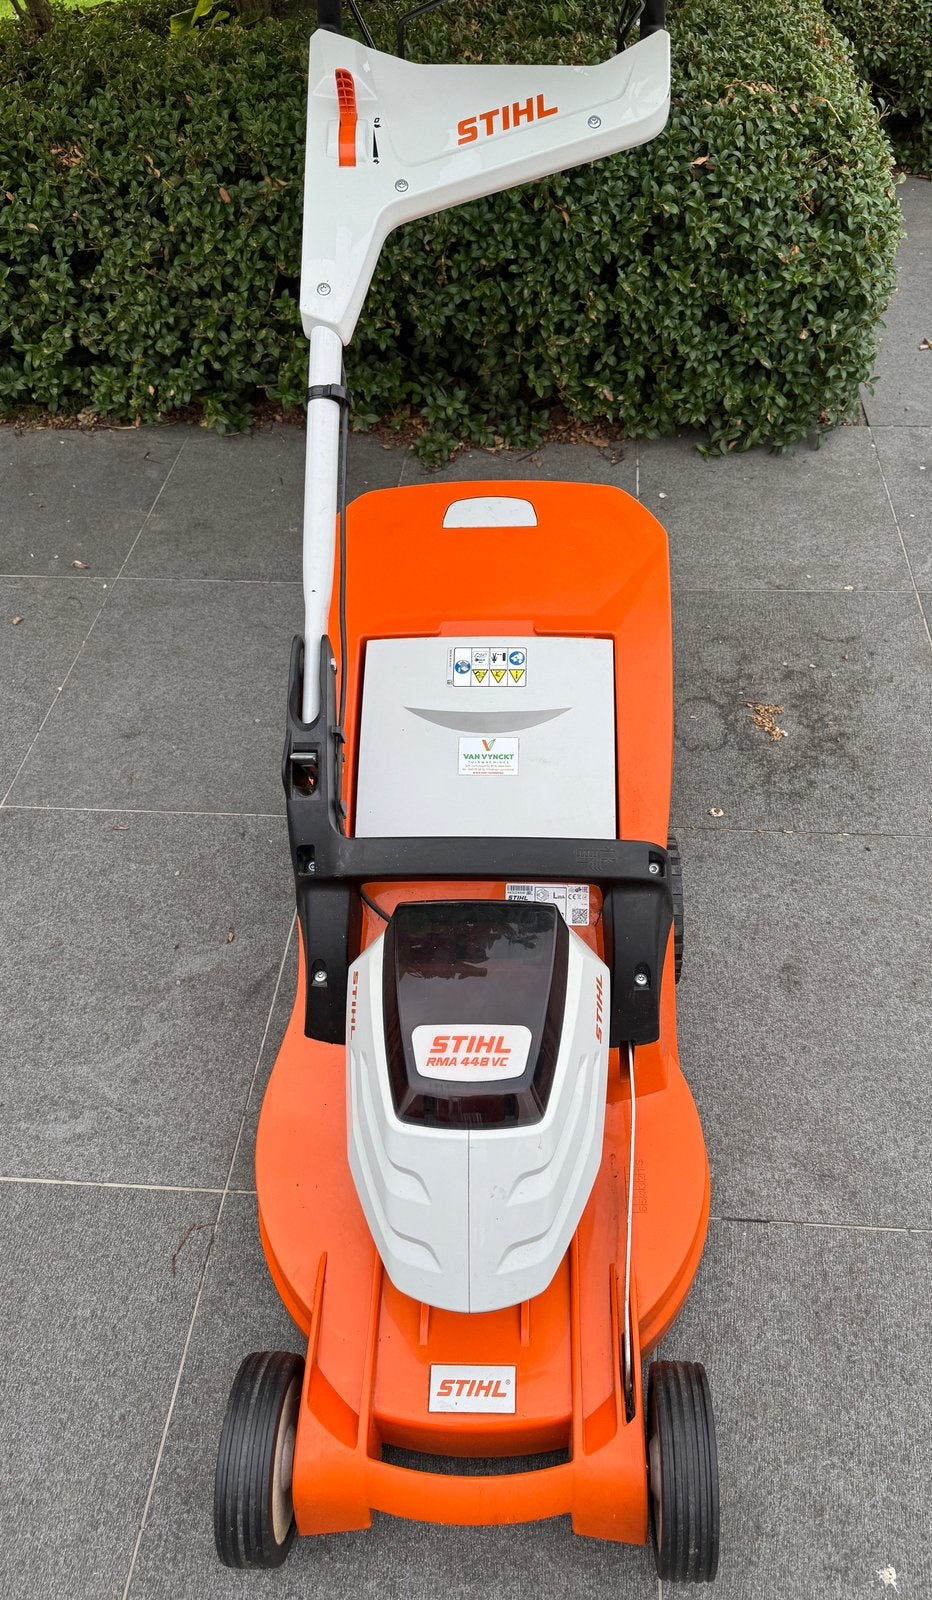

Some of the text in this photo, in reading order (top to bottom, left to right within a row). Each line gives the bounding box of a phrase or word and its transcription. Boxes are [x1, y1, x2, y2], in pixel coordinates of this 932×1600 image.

[458, 93, 558, 145] STIHL
[351, 971, 359, 1041] STIHL
[426, 1057, 509, 1067] RMA 448 VC
[430, 1035, 511, 1054] STIHL
